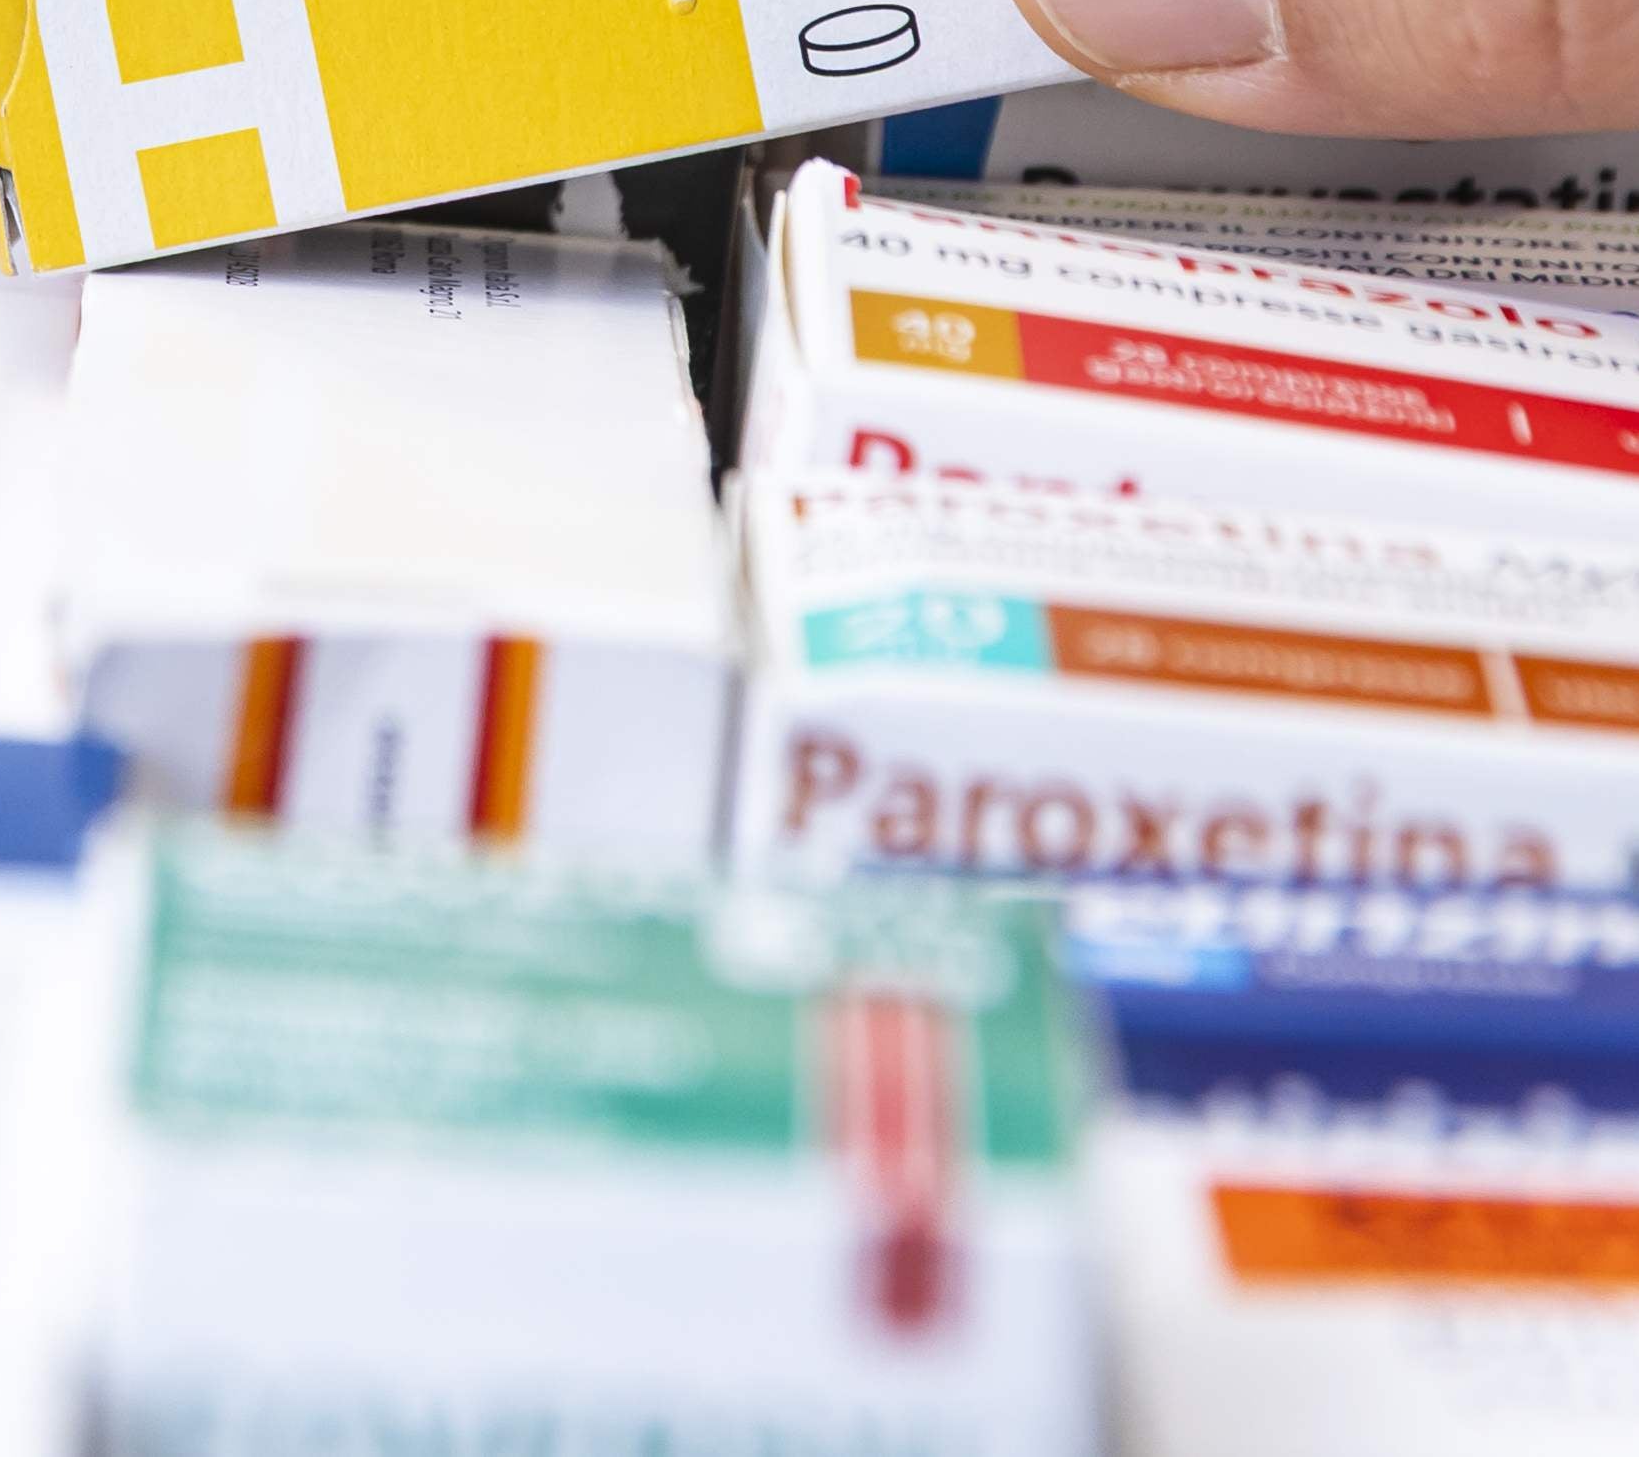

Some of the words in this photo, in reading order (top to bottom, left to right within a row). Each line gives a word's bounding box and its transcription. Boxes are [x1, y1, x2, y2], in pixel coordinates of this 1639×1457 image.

[1267, 225, 1583, 252] CONTENITORE
[838, 228, 913, 257] 40
[936, 245, 1033, 279] mg
[1056, 263, 1385, 331] compresse
[1426, 268, 1498, 283] DEI
